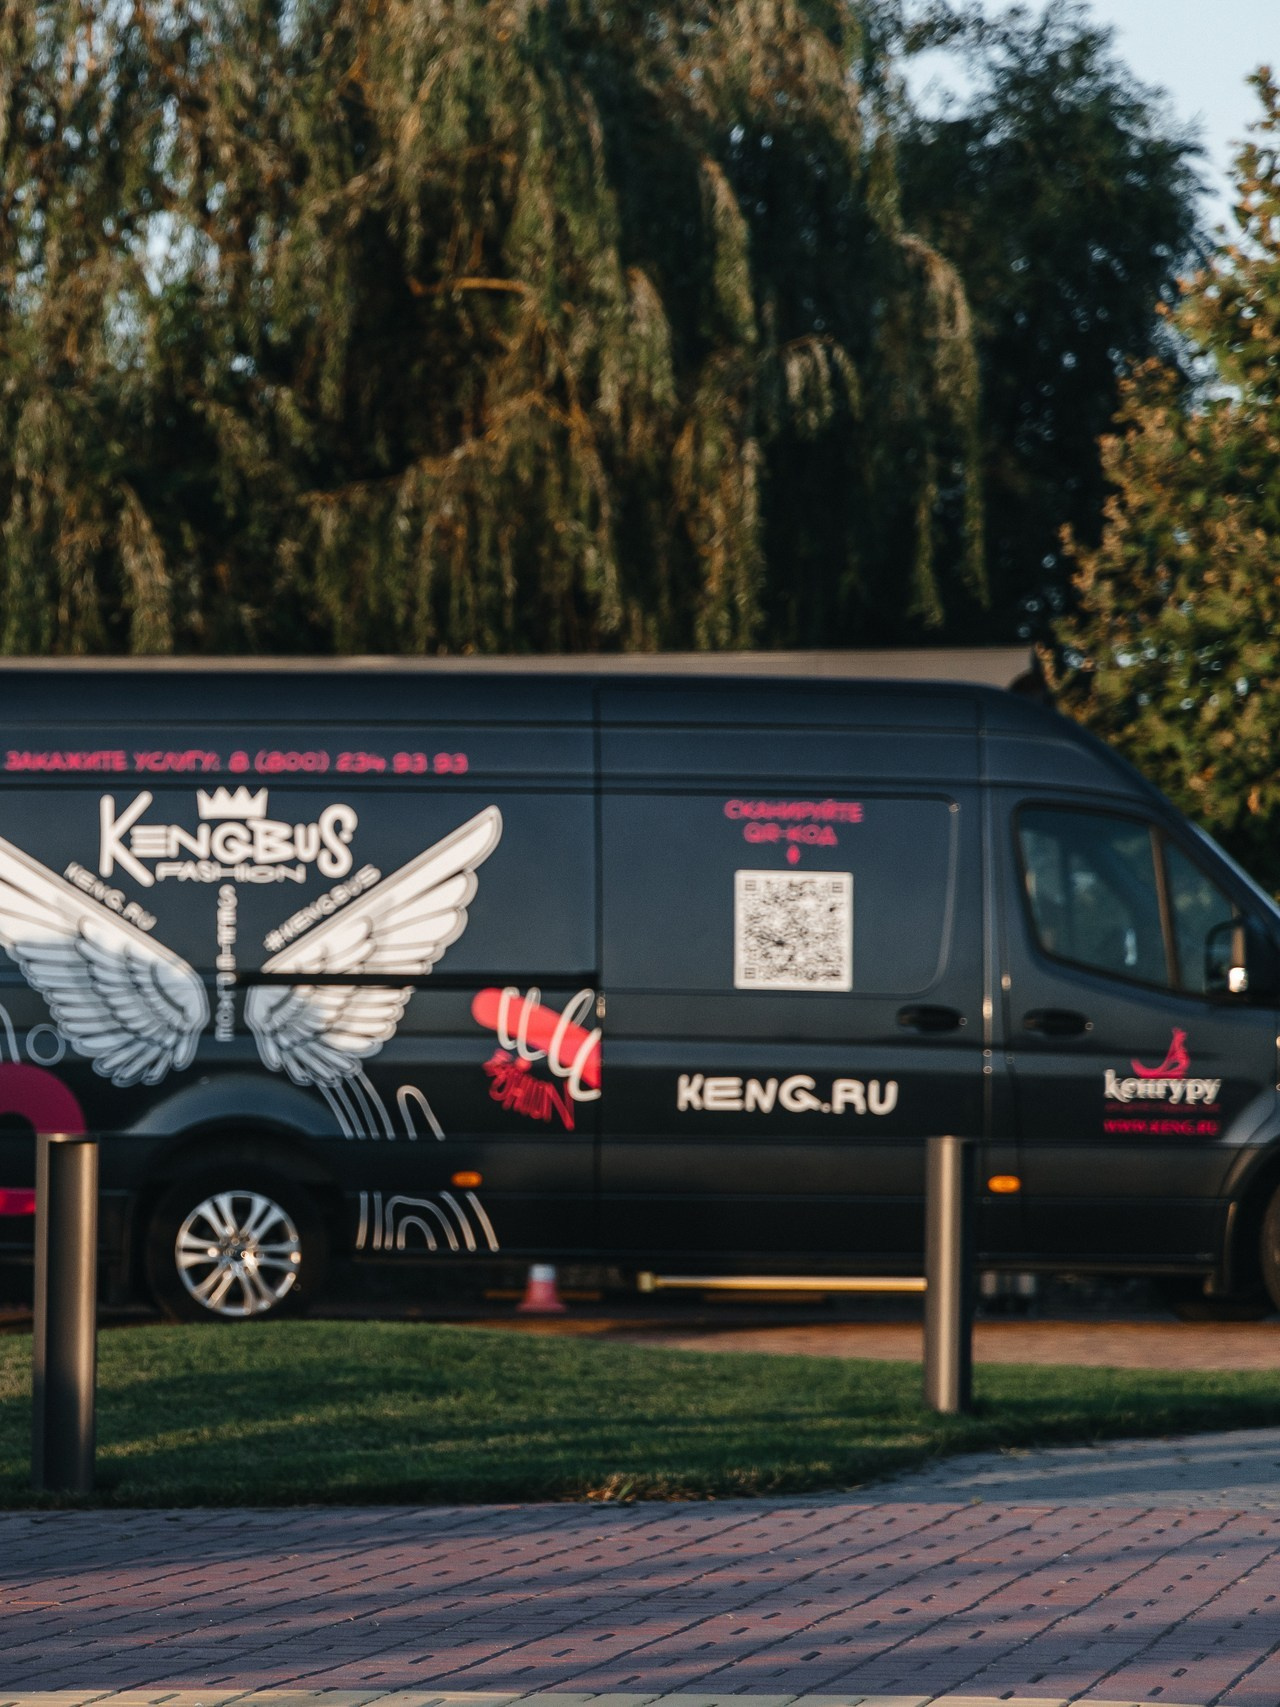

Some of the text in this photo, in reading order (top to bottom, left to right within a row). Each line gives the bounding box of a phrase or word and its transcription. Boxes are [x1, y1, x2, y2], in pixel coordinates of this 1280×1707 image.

[5, 750, 127, 772] ЗАКАЖИТЕ
[228, 751, 249, 774] 8
[255, 749, 330, 774] (800)
[155, 860, 306, 884] FASHION
[677, 1073, 899, 1116] KENG.RU
